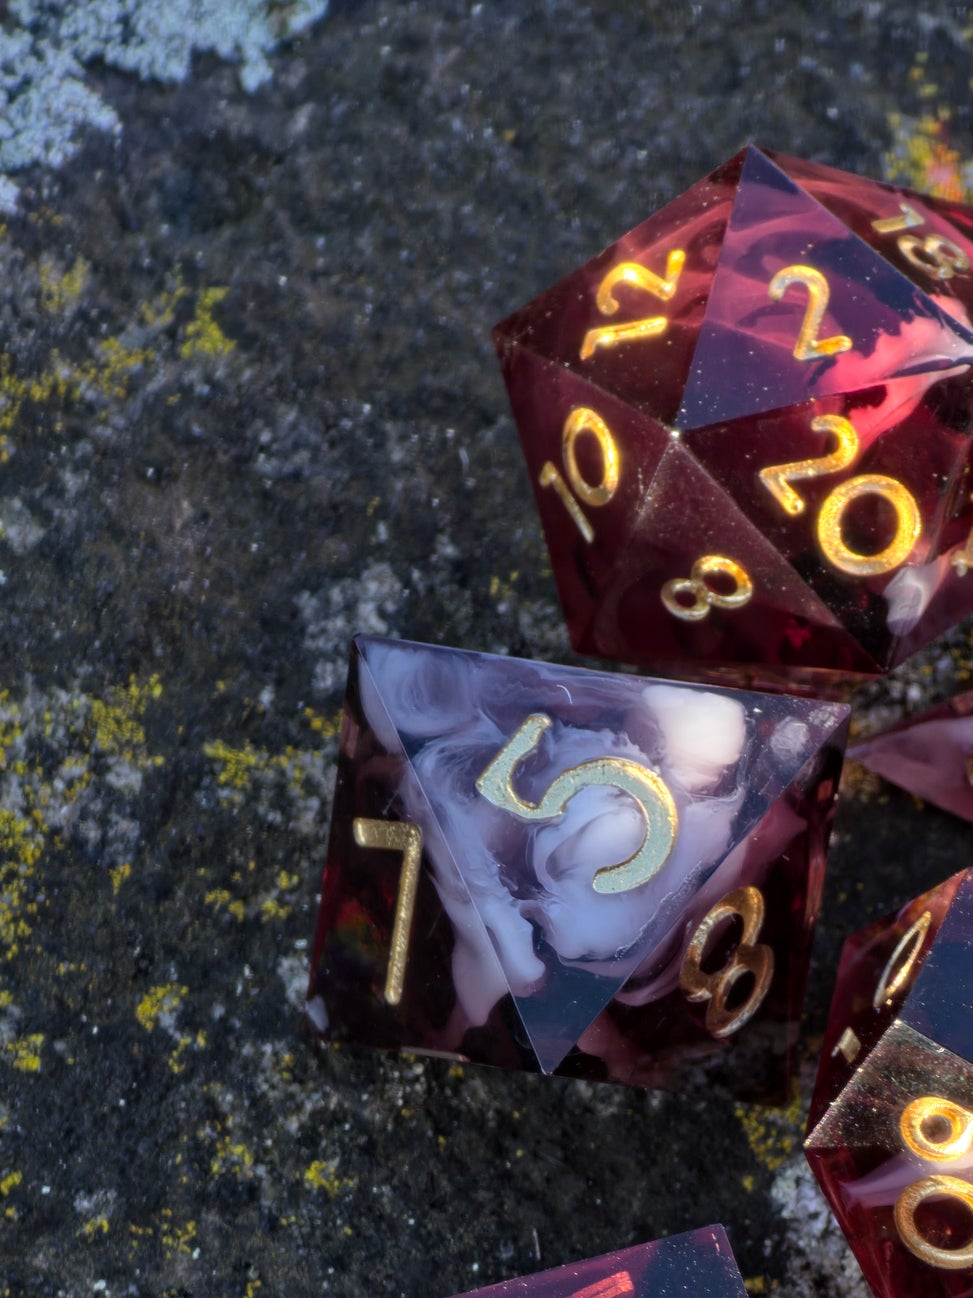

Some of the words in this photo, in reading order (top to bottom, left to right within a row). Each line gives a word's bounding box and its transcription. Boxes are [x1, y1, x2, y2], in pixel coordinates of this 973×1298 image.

[579, 250, 684, 361] 12
[768, 264, 853, 360] 2
[538, 406, 620, 543] 10
[758, 414, 922, 576] 20
[660, 554, 753, 621] 8
[475, 712, 679, 894] 5
[351, 816, 423, 1006] 7
[680, 885, 775, 1039] 8
